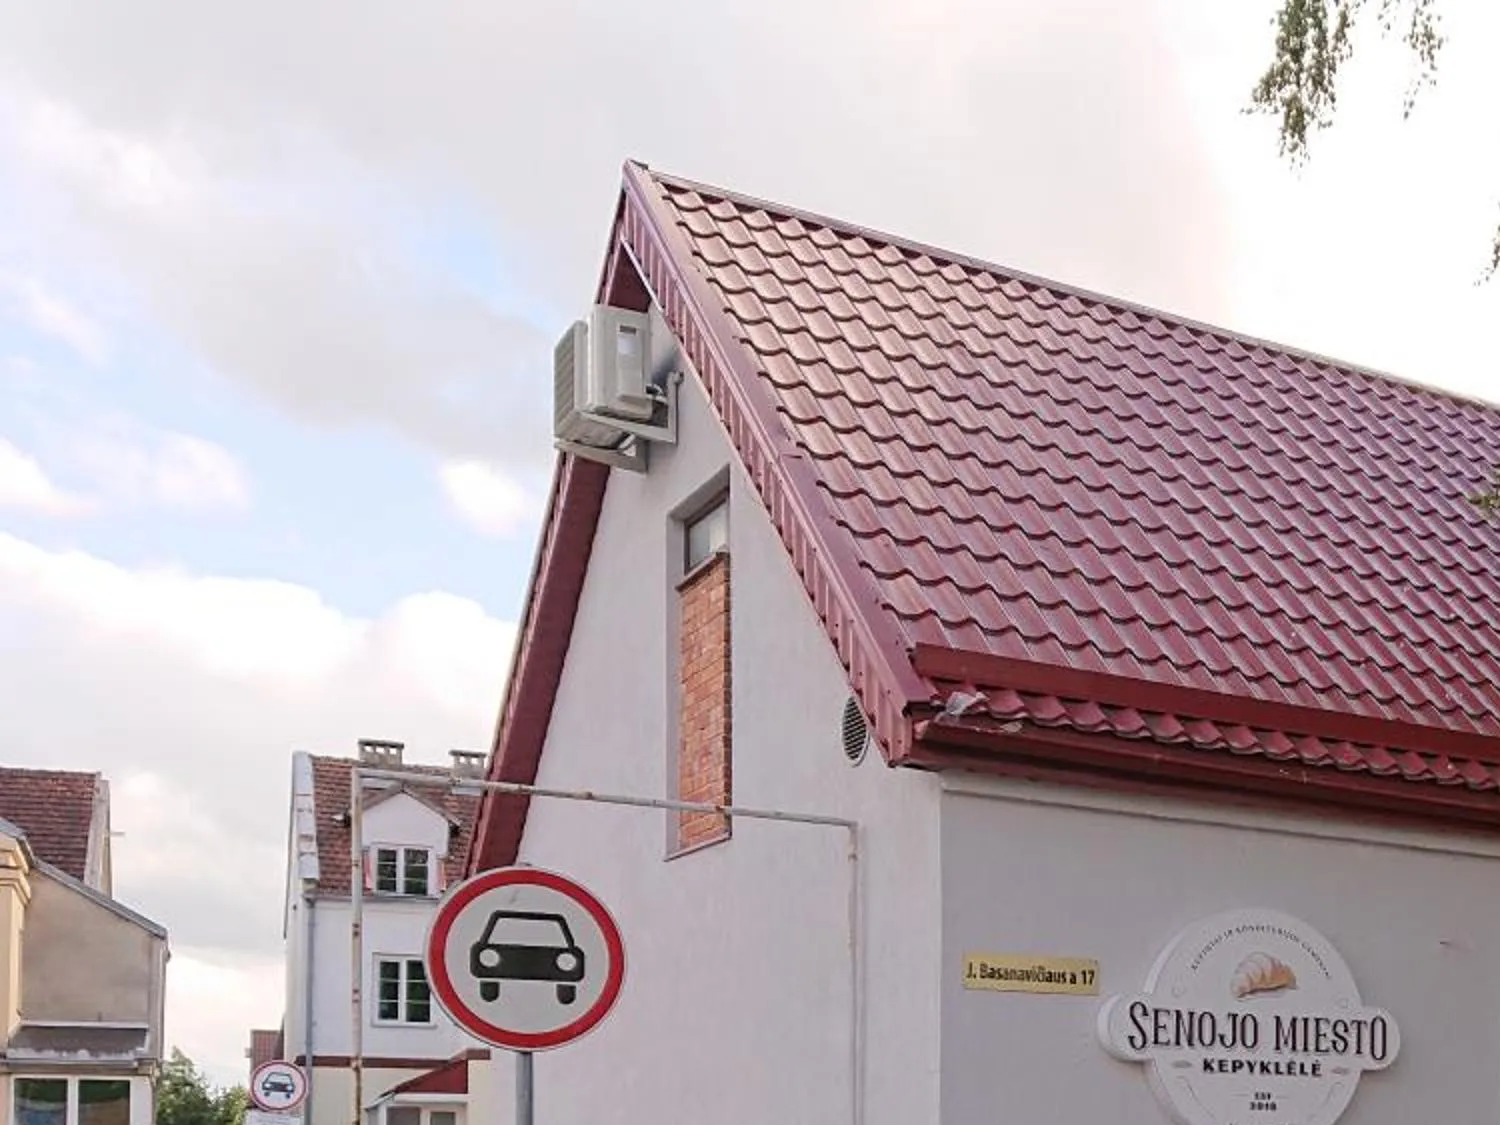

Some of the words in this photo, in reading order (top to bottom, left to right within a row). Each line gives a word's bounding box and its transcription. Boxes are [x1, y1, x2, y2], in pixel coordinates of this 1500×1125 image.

[966, 961, 977, 979] J.
[1080, 969, 1096, 986] 17
[1128, 1001, 1260, 1051] SENOJO
[1274, 1014, 1388, 1061] MIESTO
[1202, 1057, 1323, 1077] KEPYKLĖLĖ
